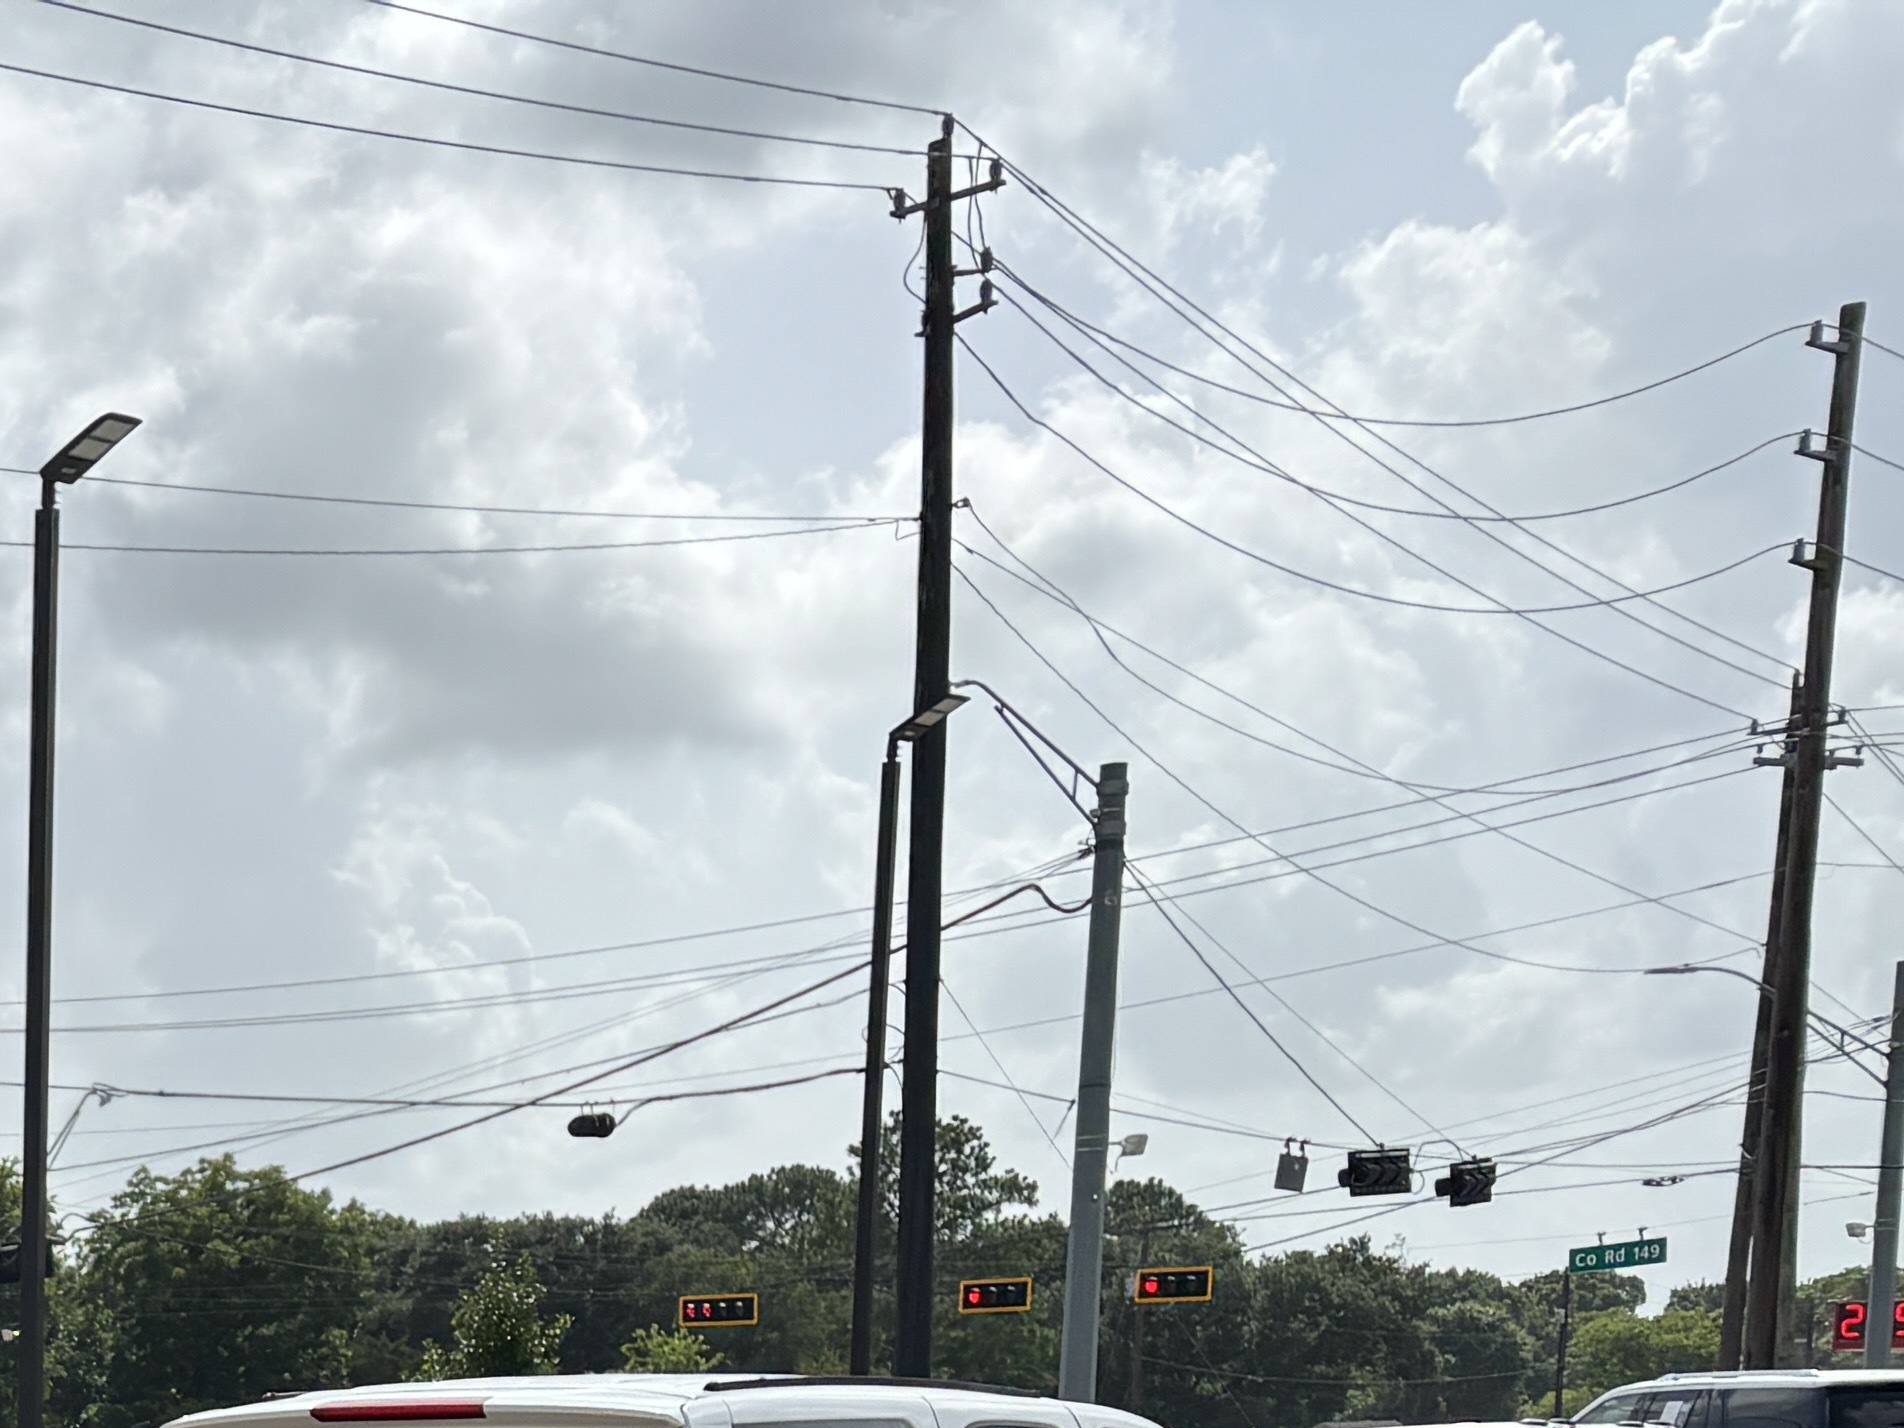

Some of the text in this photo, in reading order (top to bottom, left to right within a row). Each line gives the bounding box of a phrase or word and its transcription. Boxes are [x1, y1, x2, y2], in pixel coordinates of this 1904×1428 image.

[1575, 1244, 1661, 1267] Co Rd 149
